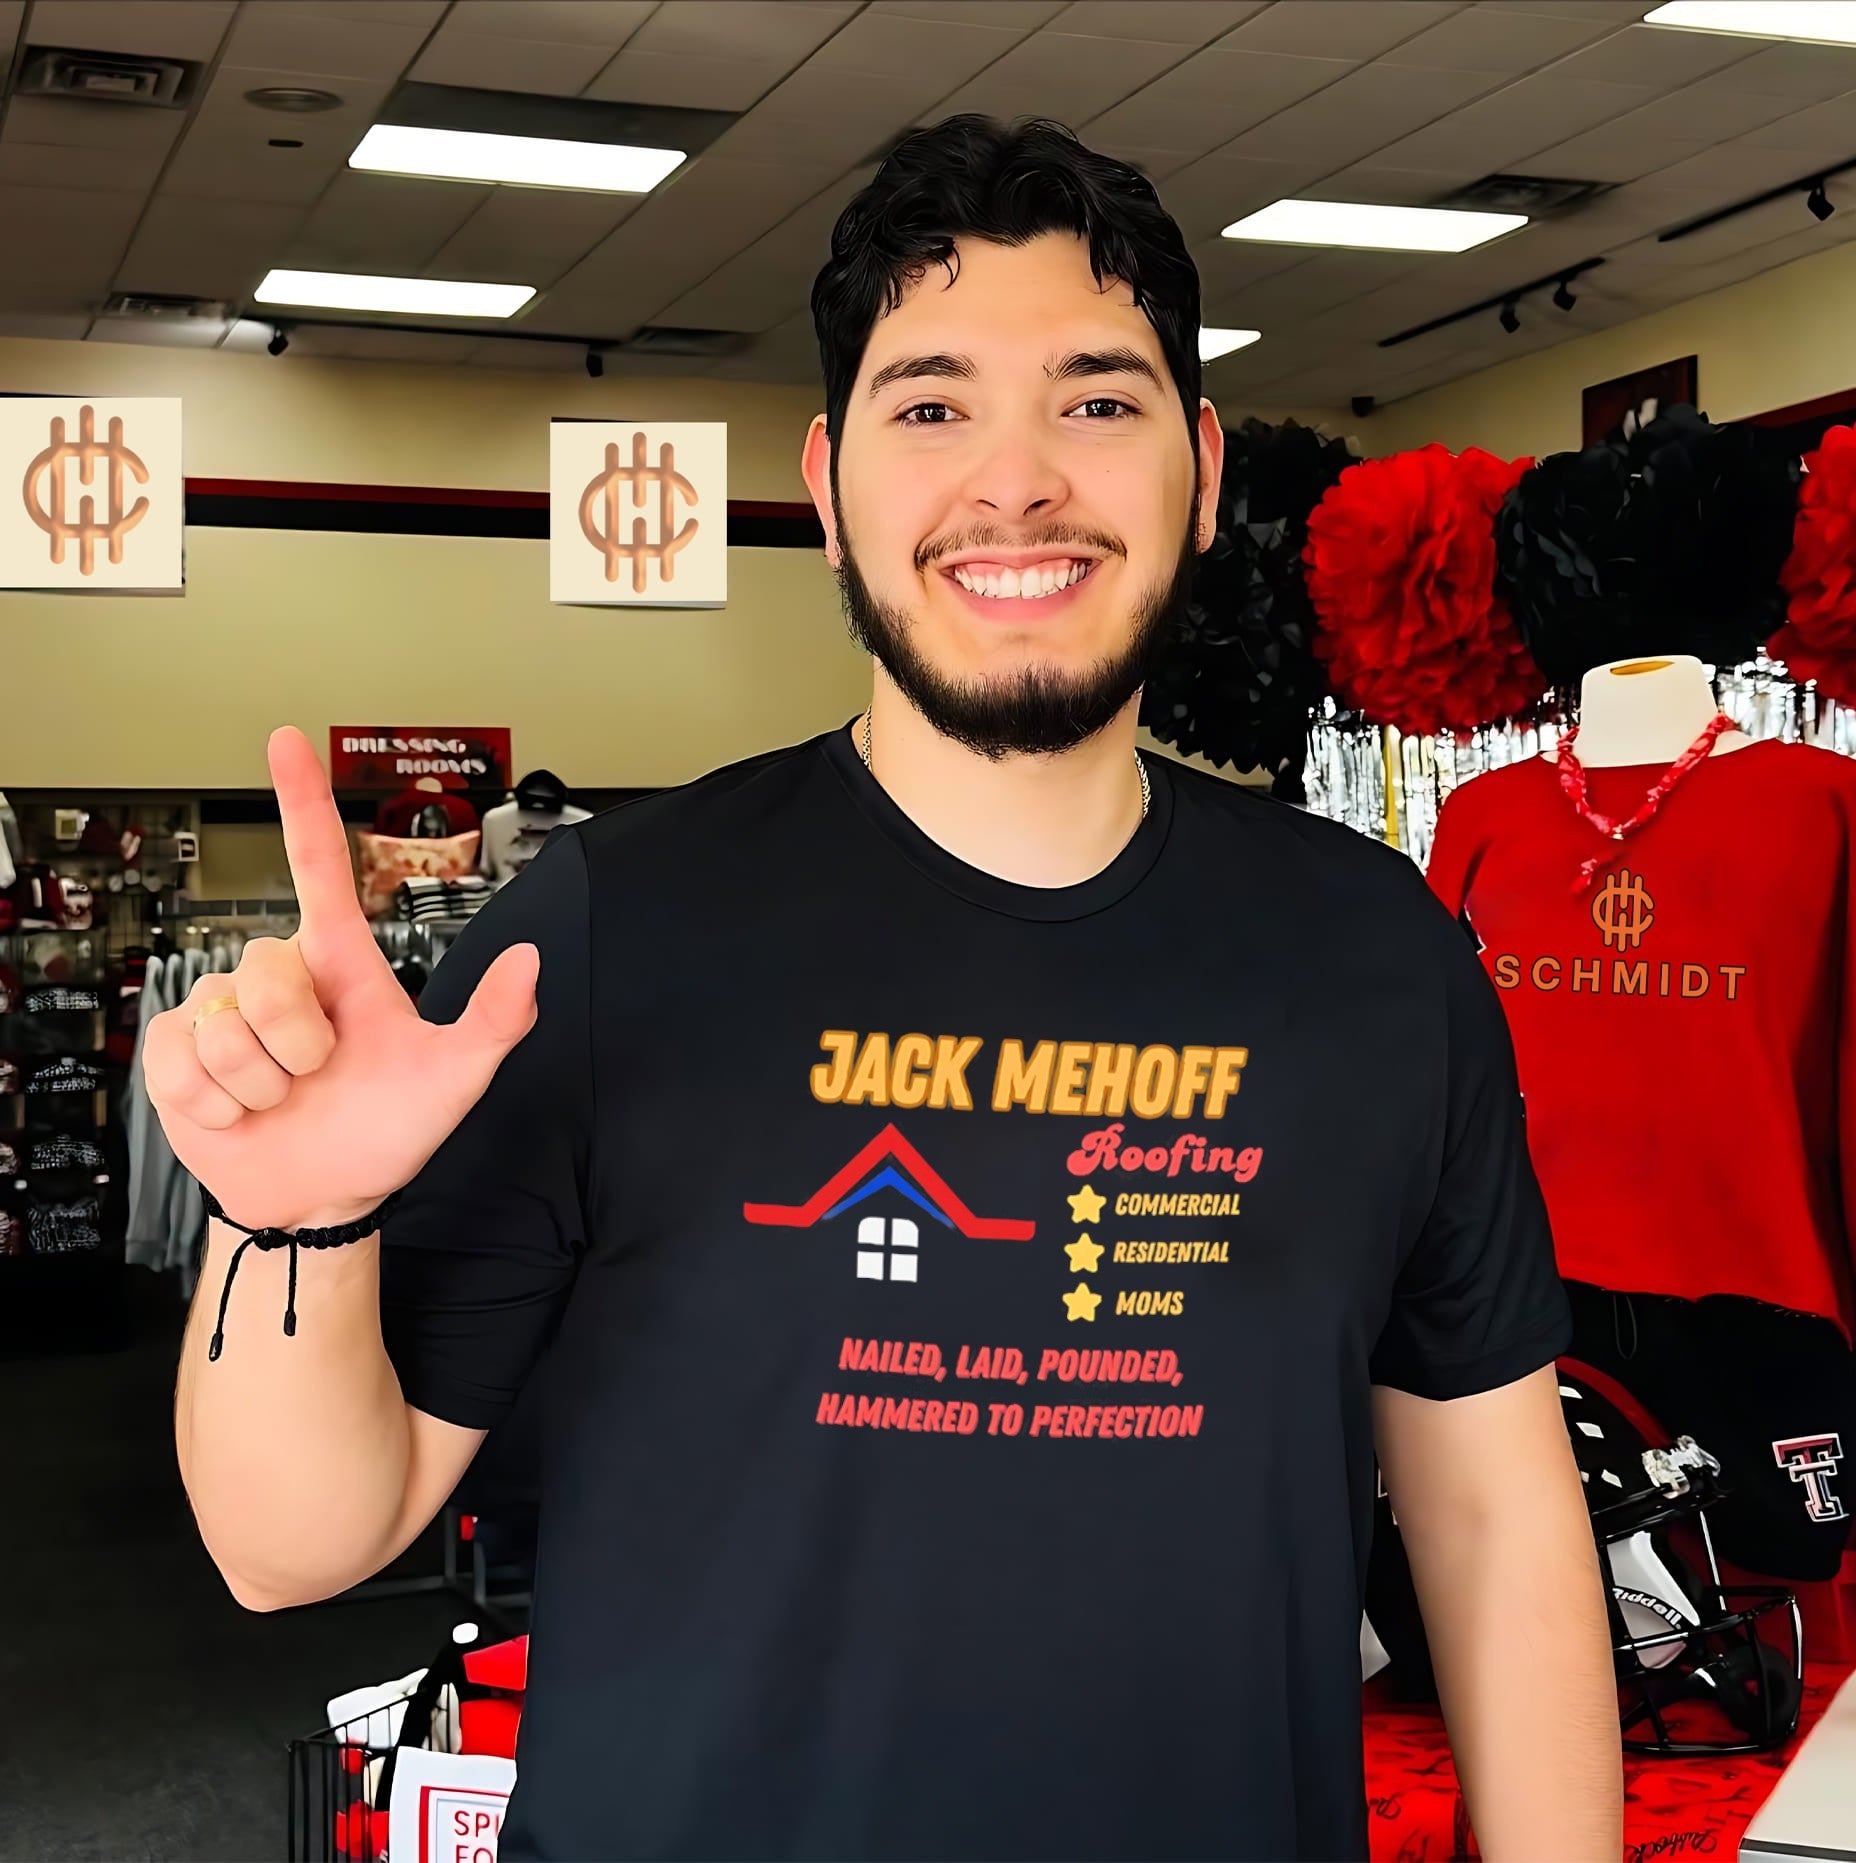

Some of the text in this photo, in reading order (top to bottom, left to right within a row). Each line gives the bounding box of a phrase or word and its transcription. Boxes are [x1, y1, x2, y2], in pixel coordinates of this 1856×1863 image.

[342, 737, 467, 753] DRESSING
[396, 758, 487, 775] ROOMS
[1494, 954, 1746, 999] SCHMIDT
[811, 1030, 1248, 1119] JACK MEHOFF
[1066, 1123, 1263, 1183] Roofing
[1115, 1193, 1241, 1216] COMMERCIAL
[1113, 1241, 1229, 1263] RESIDENTIAL
[1115, 1291, 1184, 1315] MOMS
[838, 1337, 1184, 1387] NAILED, LAID, POUNDED,
[816, 1393, 1203, 1438] HAMMERED TO PERFECTION
